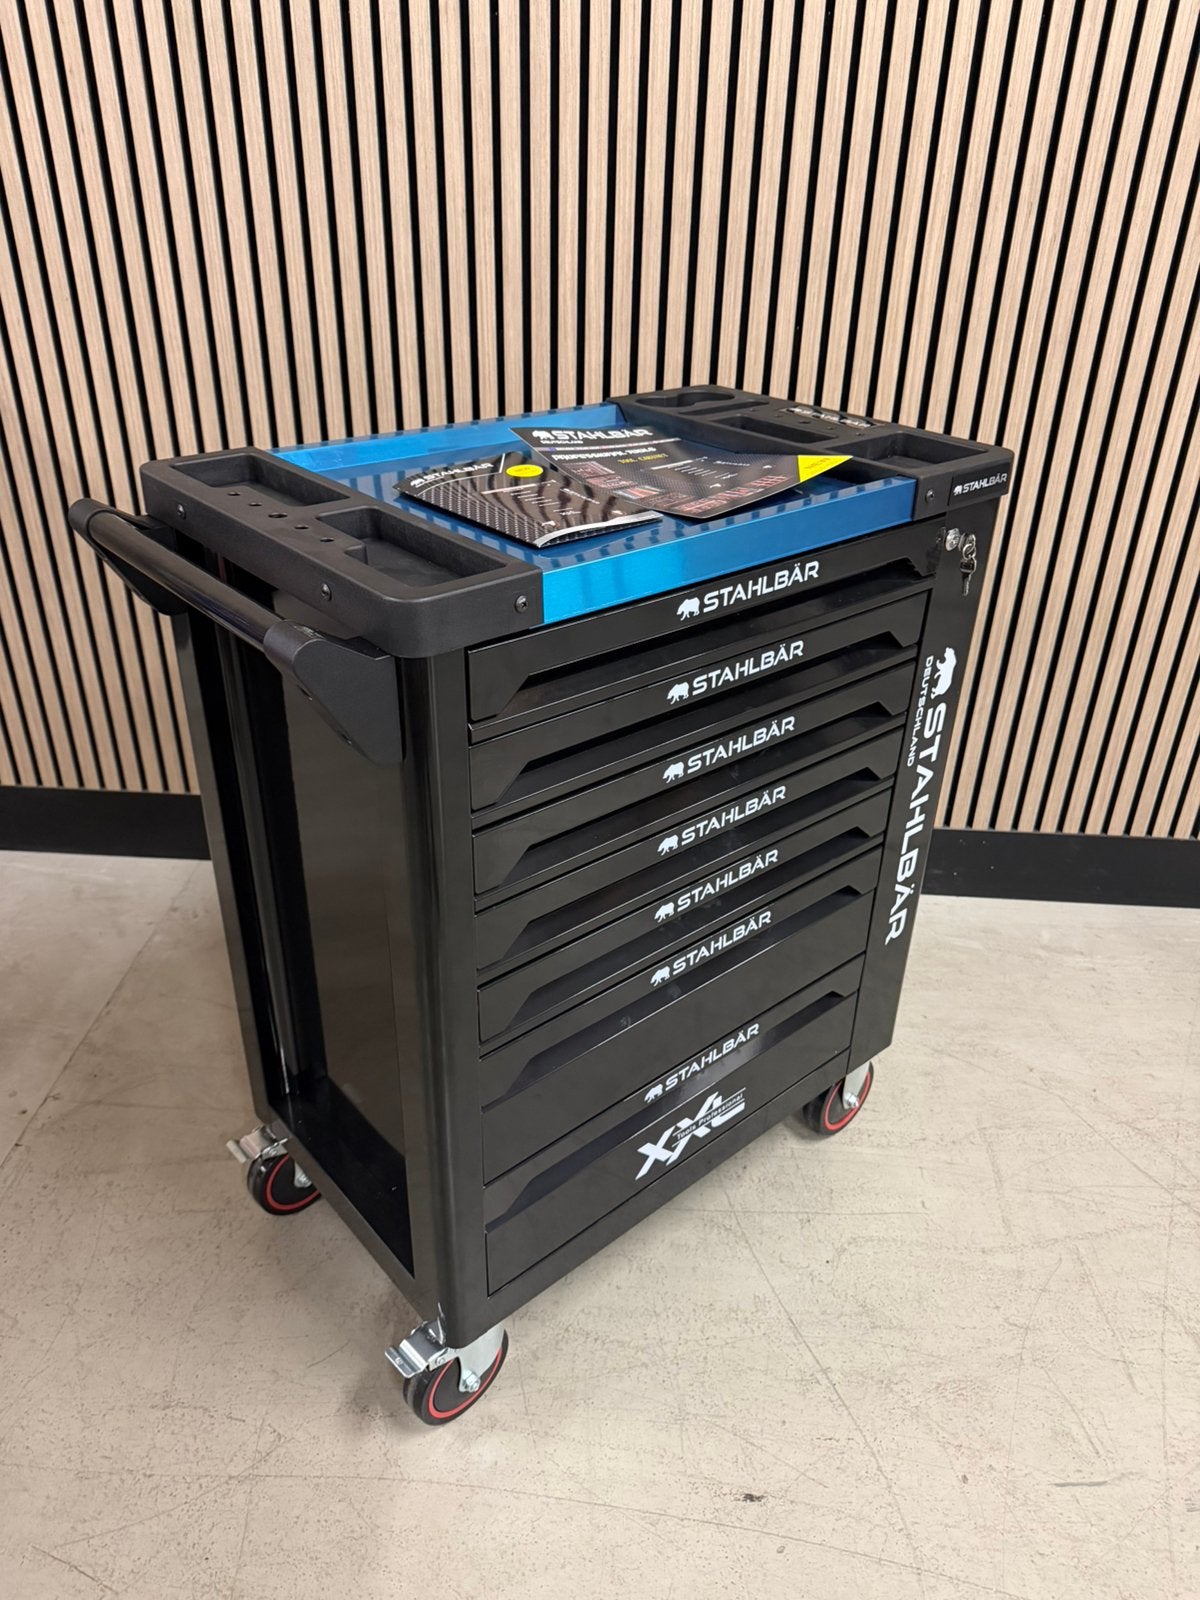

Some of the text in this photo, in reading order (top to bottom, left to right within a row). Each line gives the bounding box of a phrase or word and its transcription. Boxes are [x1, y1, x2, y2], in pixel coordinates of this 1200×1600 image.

[962, 472, 1009, 493] STAHLBÄR
[703, 561, 819, 612] STAHLBÄR
[692, 640, 804, 696] STAHLBÄR
[907, 655, 934, 767] DEUTSCHLAND
[687, 716, 795, 774] STAHLBÄR
[681, 785, 786, 846] STAHLBÄR
[884, 702, 947, 946] STAHLBÄR
[677, 850, 779, 912] STAHLBÄR
[672, 911, 772, 976] STAHLBÄR
[665, 1023, 760, 1092] STAHLBÄR
[676, 1092, 744, 1140] Tools Professional
